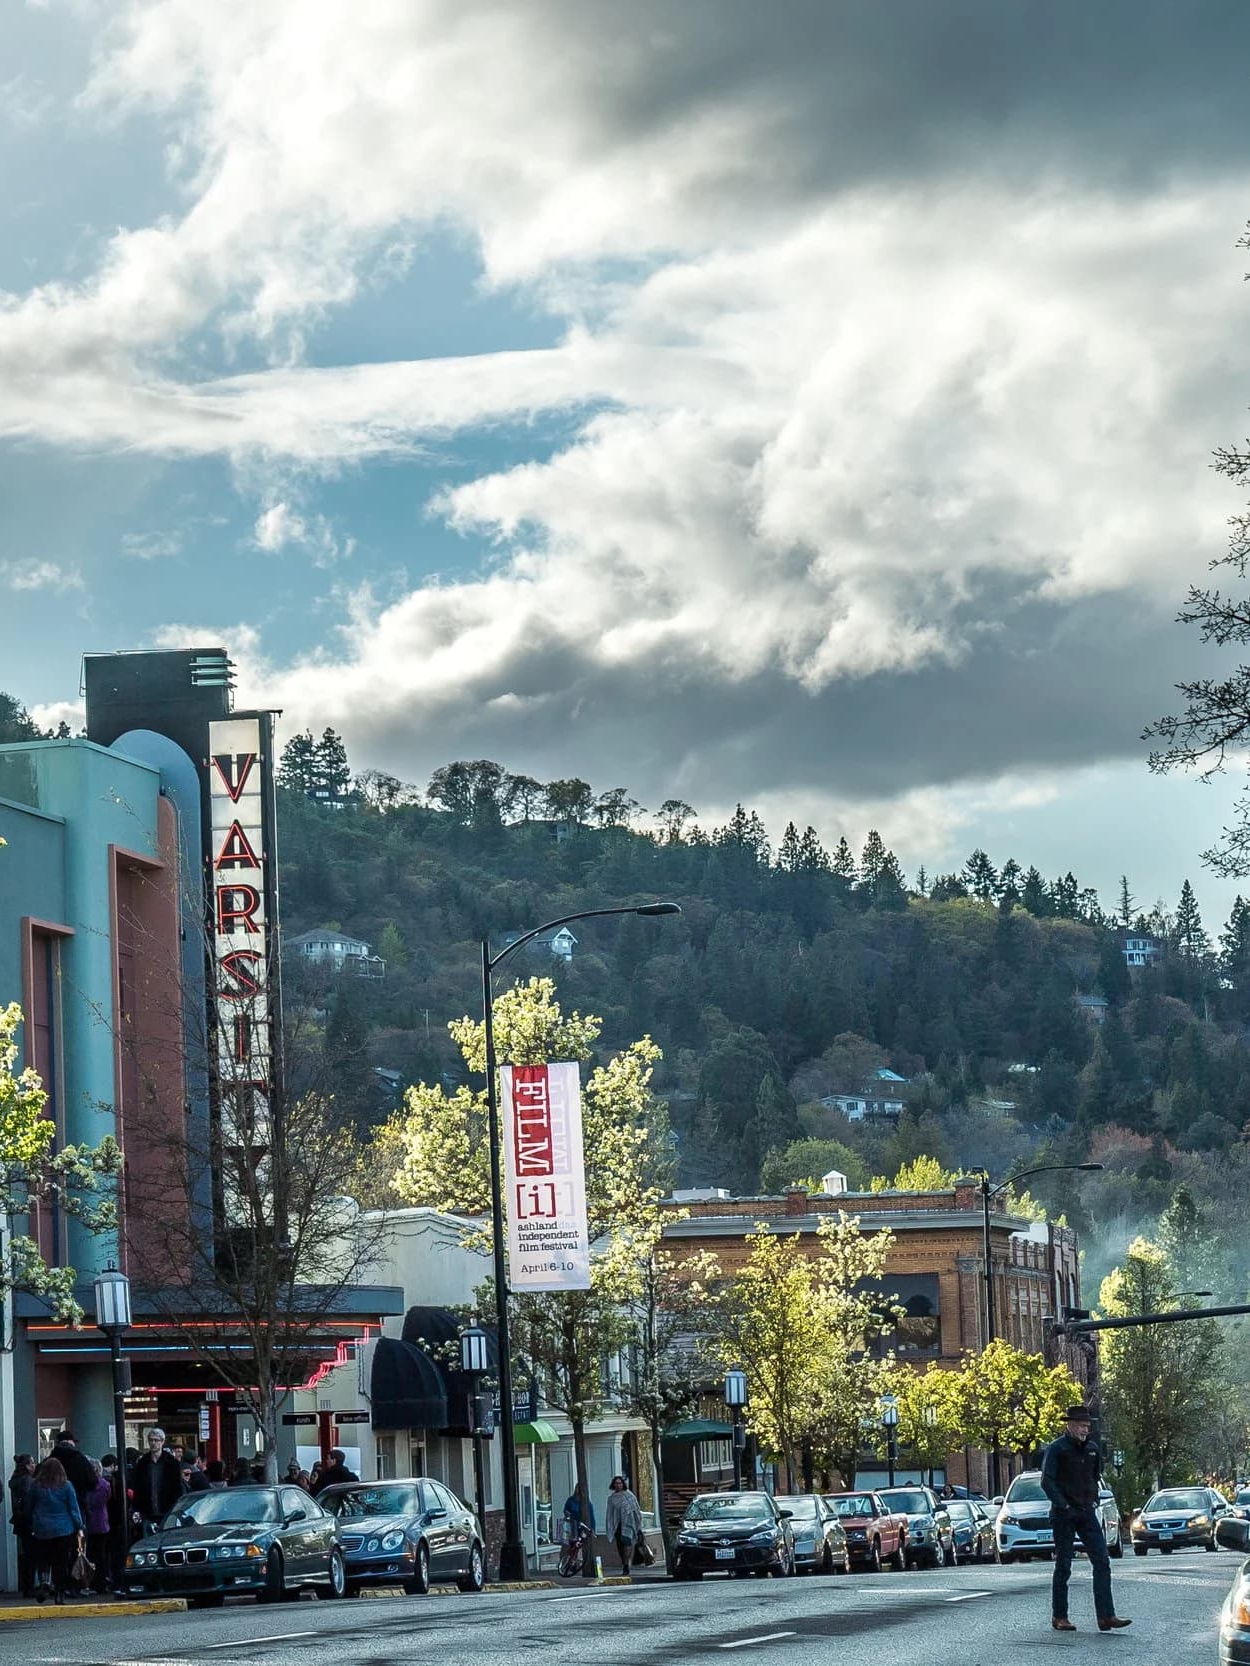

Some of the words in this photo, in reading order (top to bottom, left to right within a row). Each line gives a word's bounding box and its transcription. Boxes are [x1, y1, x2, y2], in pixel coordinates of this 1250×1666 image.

[211, 752, 269, 1198] VARSITY
[516, 1077, 550, 1174] FILM
[518, 1221, 558, 1231] ashland
[518, 1230, 579, 1241] independent
[519, 1243, 539, 1252] film
[541, 1241, 578, 1251] festival
[521, 1263, 548, 1274] April
[550, 1262, 574, 1271] 6-10
